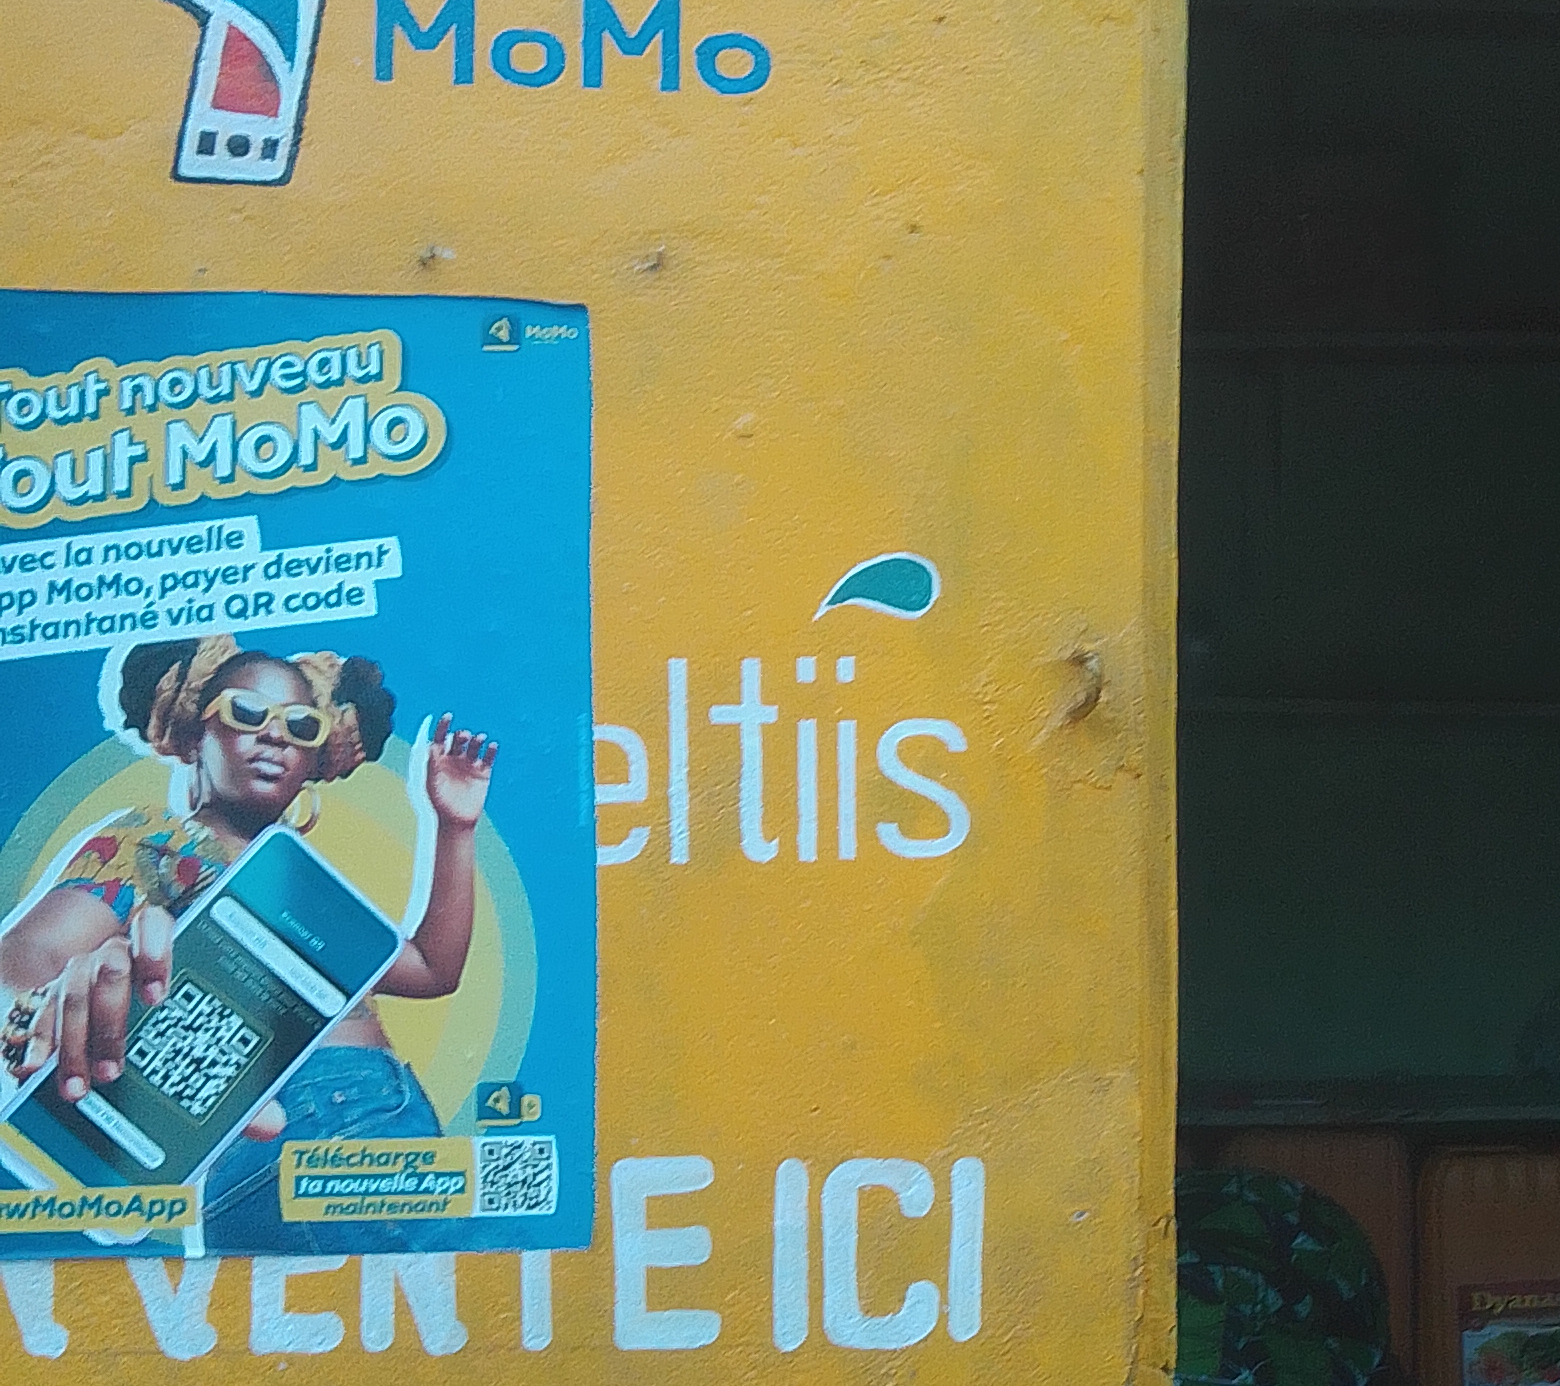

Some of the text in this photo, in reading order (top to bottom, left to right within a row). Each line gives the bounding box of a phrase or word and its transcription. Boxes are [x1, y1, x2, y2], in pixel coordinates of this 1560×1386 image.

[119, 342, 382, 412] nouveau
[0, 394, 426, 509] out MoMo
[63, 539, 95, 569] la
[103, 524, 246, 563] nouvelle
[46, 571, 154, 606] MoMo,
[157, 559, 258, 601] payer
[263, 542, 392, 580] devient
[165, 597, 216, 626] via
[223, 591, 276, 620] QR
[282, 580, 365, 614] code
[291, 1144, 438, 1173] Télécharge
[322, 1197, 452, 1217] maintenant
[325, 1172, 418, 1195] nouvelle
[420, 1173, 466, 1196] App
[773, 1156, 985, 1352] ICI
